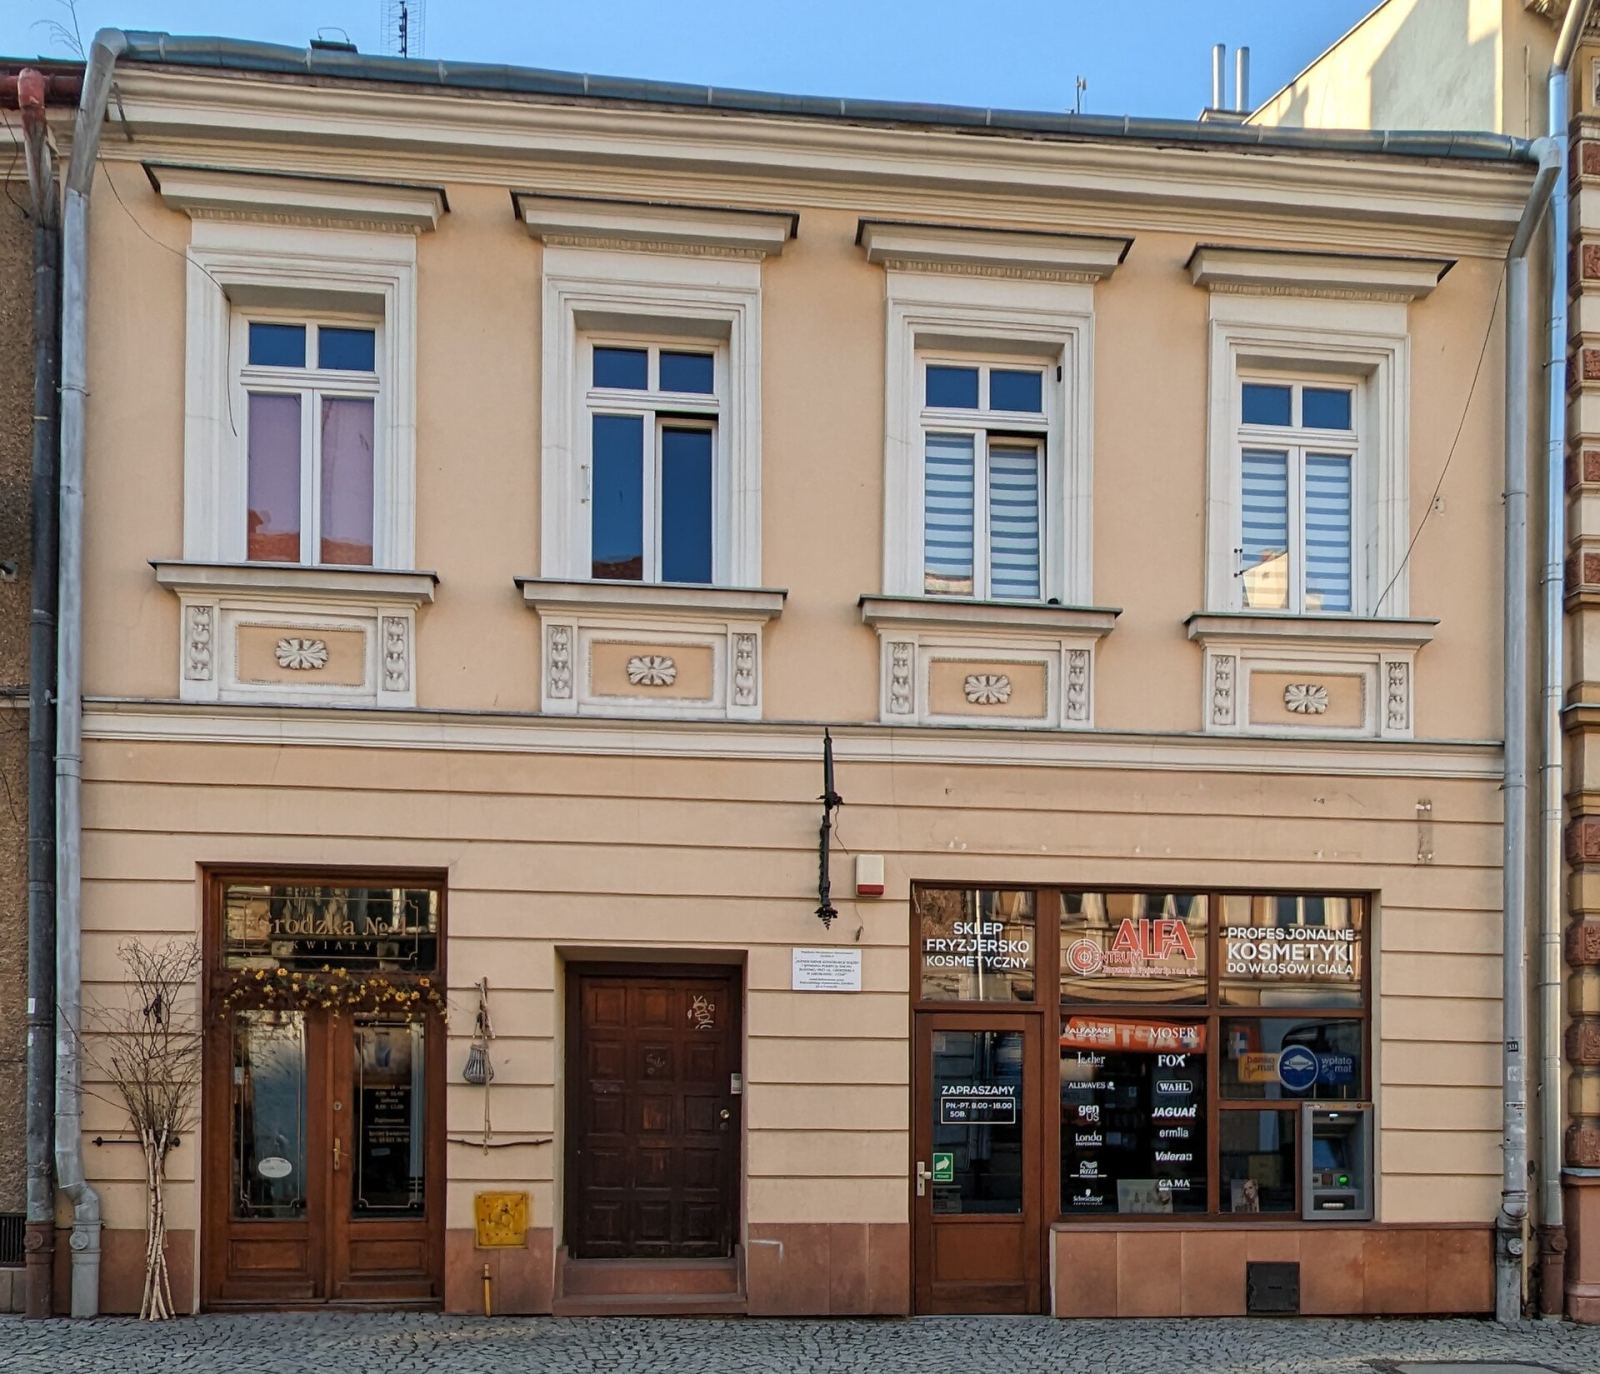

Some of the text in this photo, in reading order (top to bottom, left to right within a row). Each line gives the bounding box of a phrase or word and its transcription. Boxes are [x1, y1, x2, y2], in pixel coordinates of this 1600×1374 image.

[953, 922, 1004, 935] SKLEP
[1227, 927, 1355, 941] PROFESJONALNE
[1112, 918, 1198, 960] ALFA
[926, 939, 1030, 953] FRYZJERSKO
[1227, 942, 1354, 962] KOSMETYKI
[926, 955, 1030, 969] KOSMETYCZNY
[1227, 962, 1247, 973] DO
[1249, 961, 1309, 974] WŁOSÓW
[1150, 1026, 1195, 1040] MOSER
[1158, 1054, 1186, 1067] FOX
[941, 1085, 1015, 1095] ZAPRASZAMY
[1068, 1081, 1106, 1089] ALLWAVES
[1159, 1082, 1190, 1091] WAHL
[1078, 1104, 1100, 1116] gen
[1151, 1106, 1197, 1118] JAGUAR
[1075, 1130, 1103, 1142] Londa
[1155, 1151, 1186, 1161] Valera
